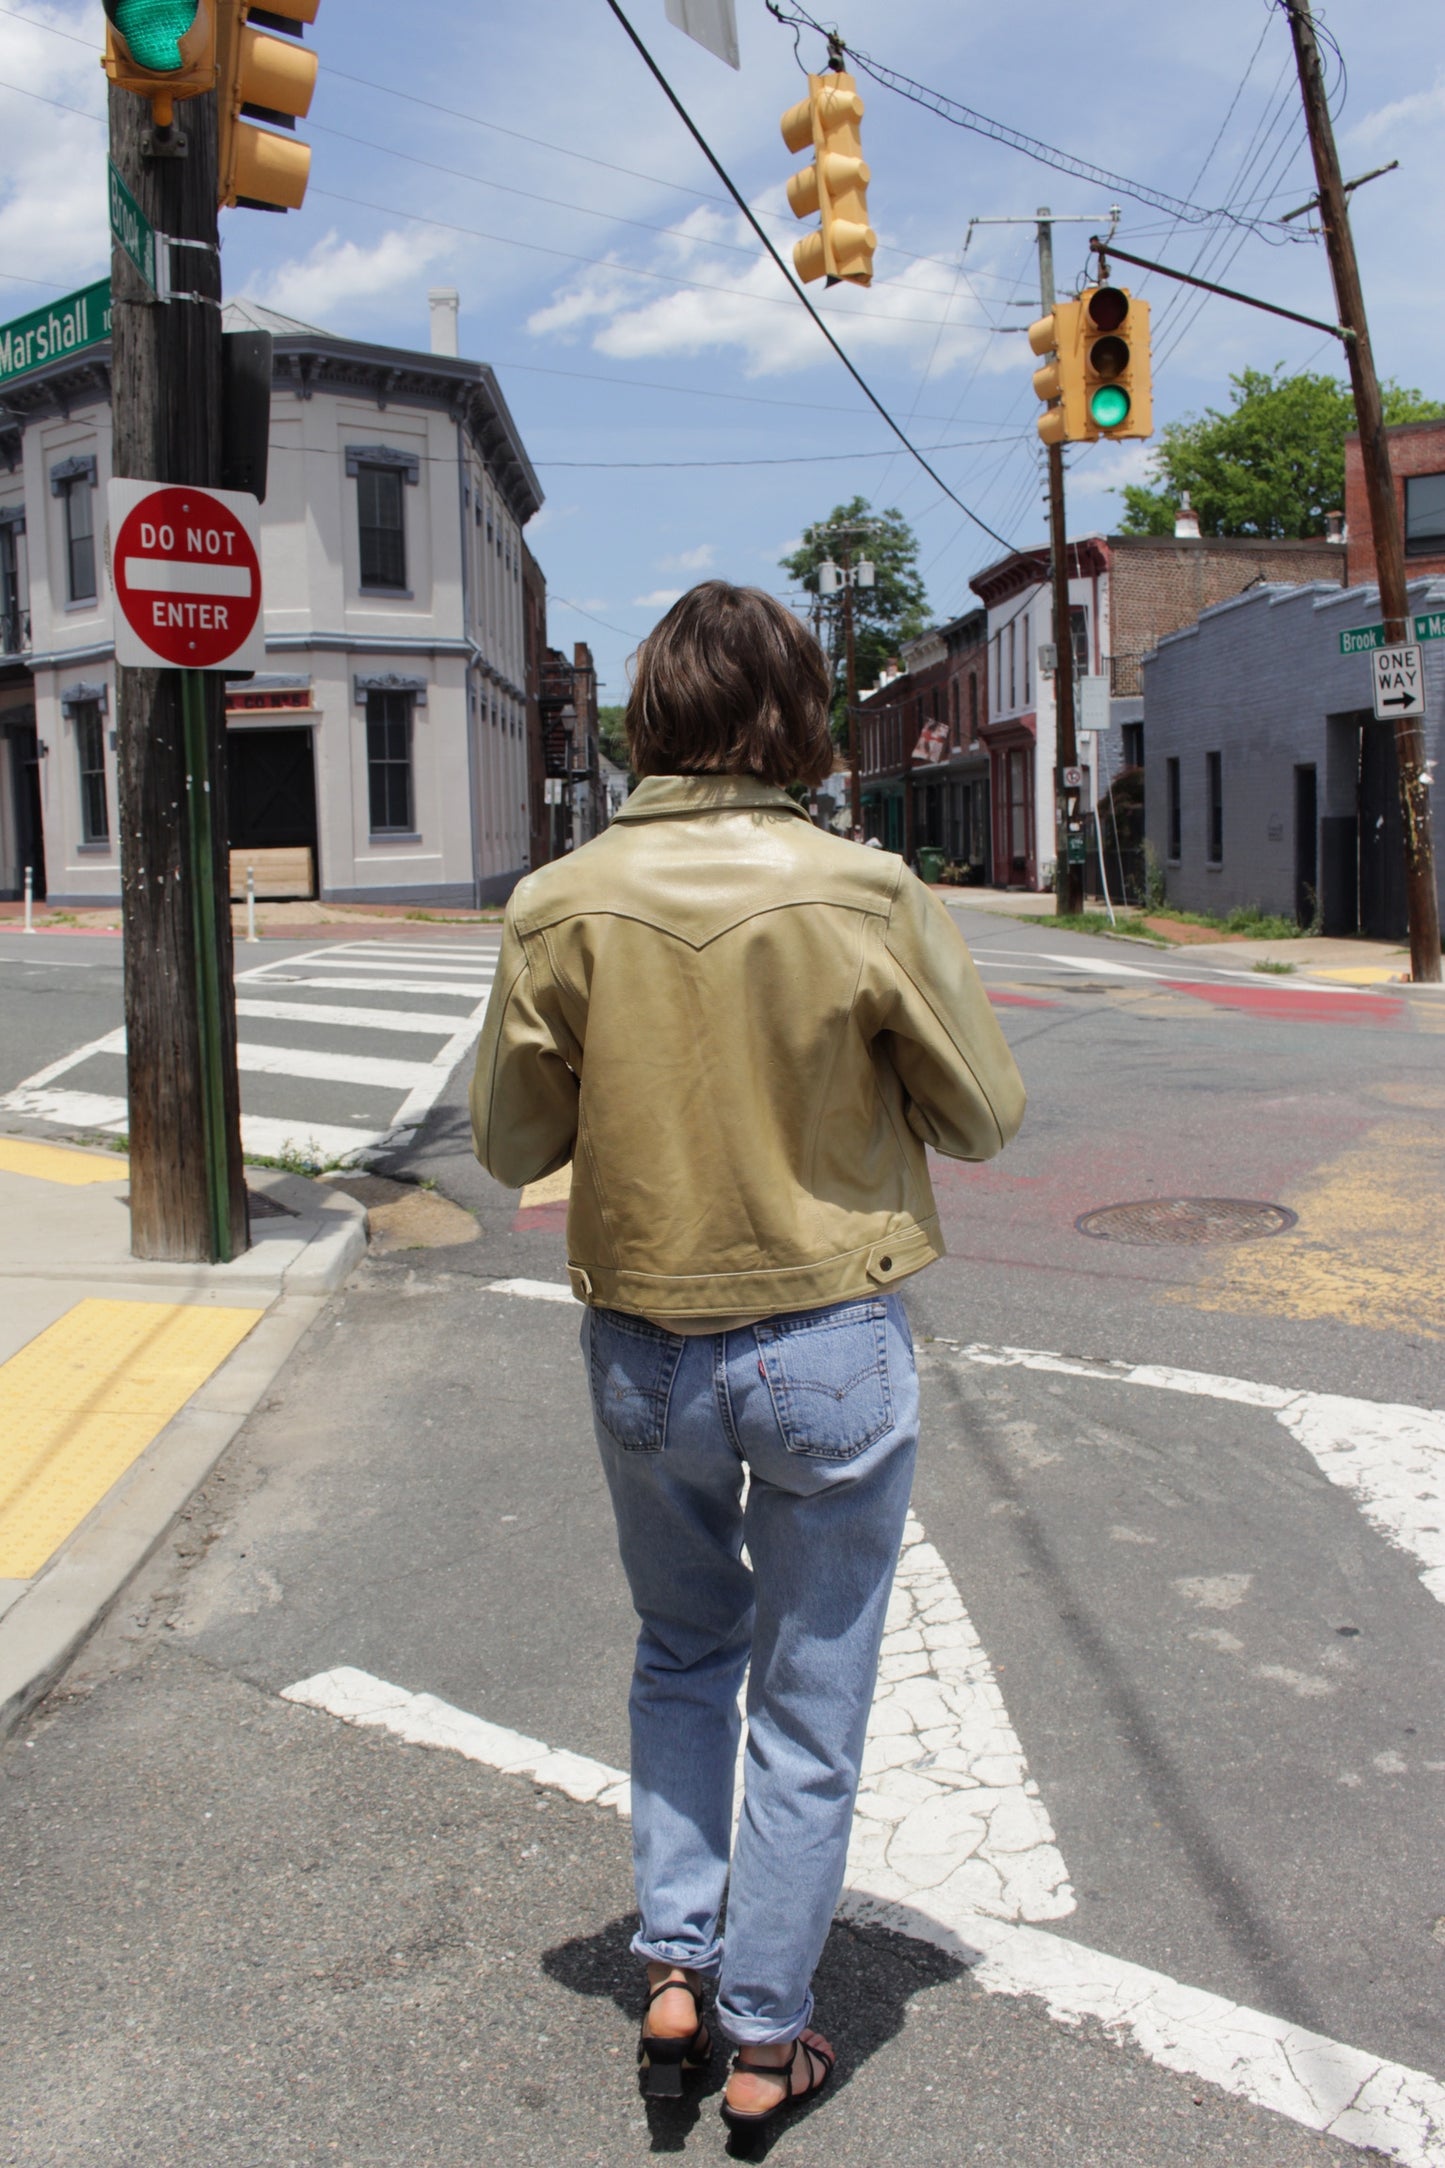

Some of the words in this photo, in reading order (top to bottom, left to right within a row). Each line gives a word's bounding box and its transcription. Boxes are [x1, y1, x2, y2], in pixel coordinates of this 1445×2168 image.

[111, 171, 140, 264] Brook
[0, 297, 88, 376] Marshall
[140, 523, 174, 551] DO
[186, 528, 236, 556] NOT
[152, 601, 229, 630] ENTER
[1342, 629, 1377, 652] Brook
[1379, 651, 1416, 671] ONE
[1378, 670, 1417, 690] WAY
